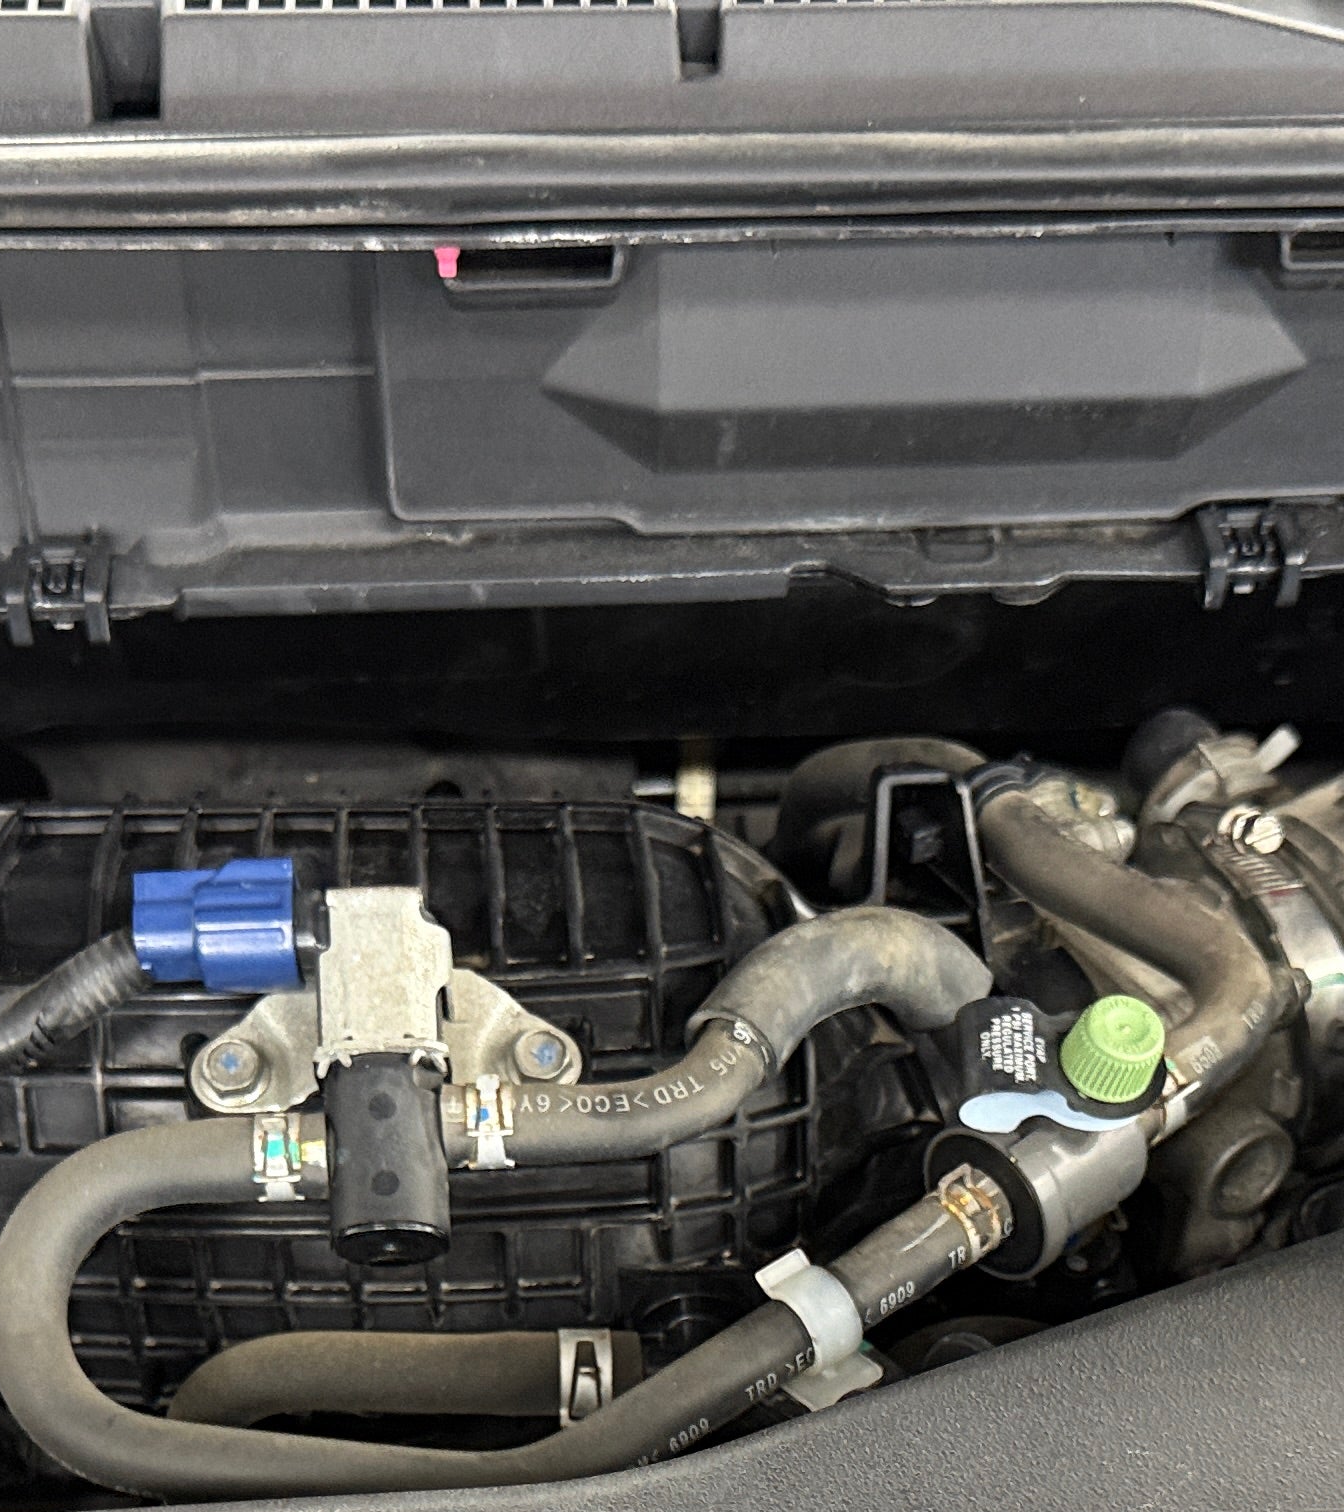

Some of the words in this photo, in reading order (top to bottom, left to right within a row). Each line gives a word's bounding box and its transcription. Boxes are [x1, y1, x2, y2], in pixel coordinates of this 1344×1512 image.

[991, 1017, 1003, 1071] PRESSURE
[1001, 1015, 1014, 1073] REGULATED
[1021, 1012, 1034, 1052] SERVICE
[652, 1074, 704, 1105] TRD
[879, 1280, 916, 1314] 6909
[744, 1372, 778, 1402] TRD
